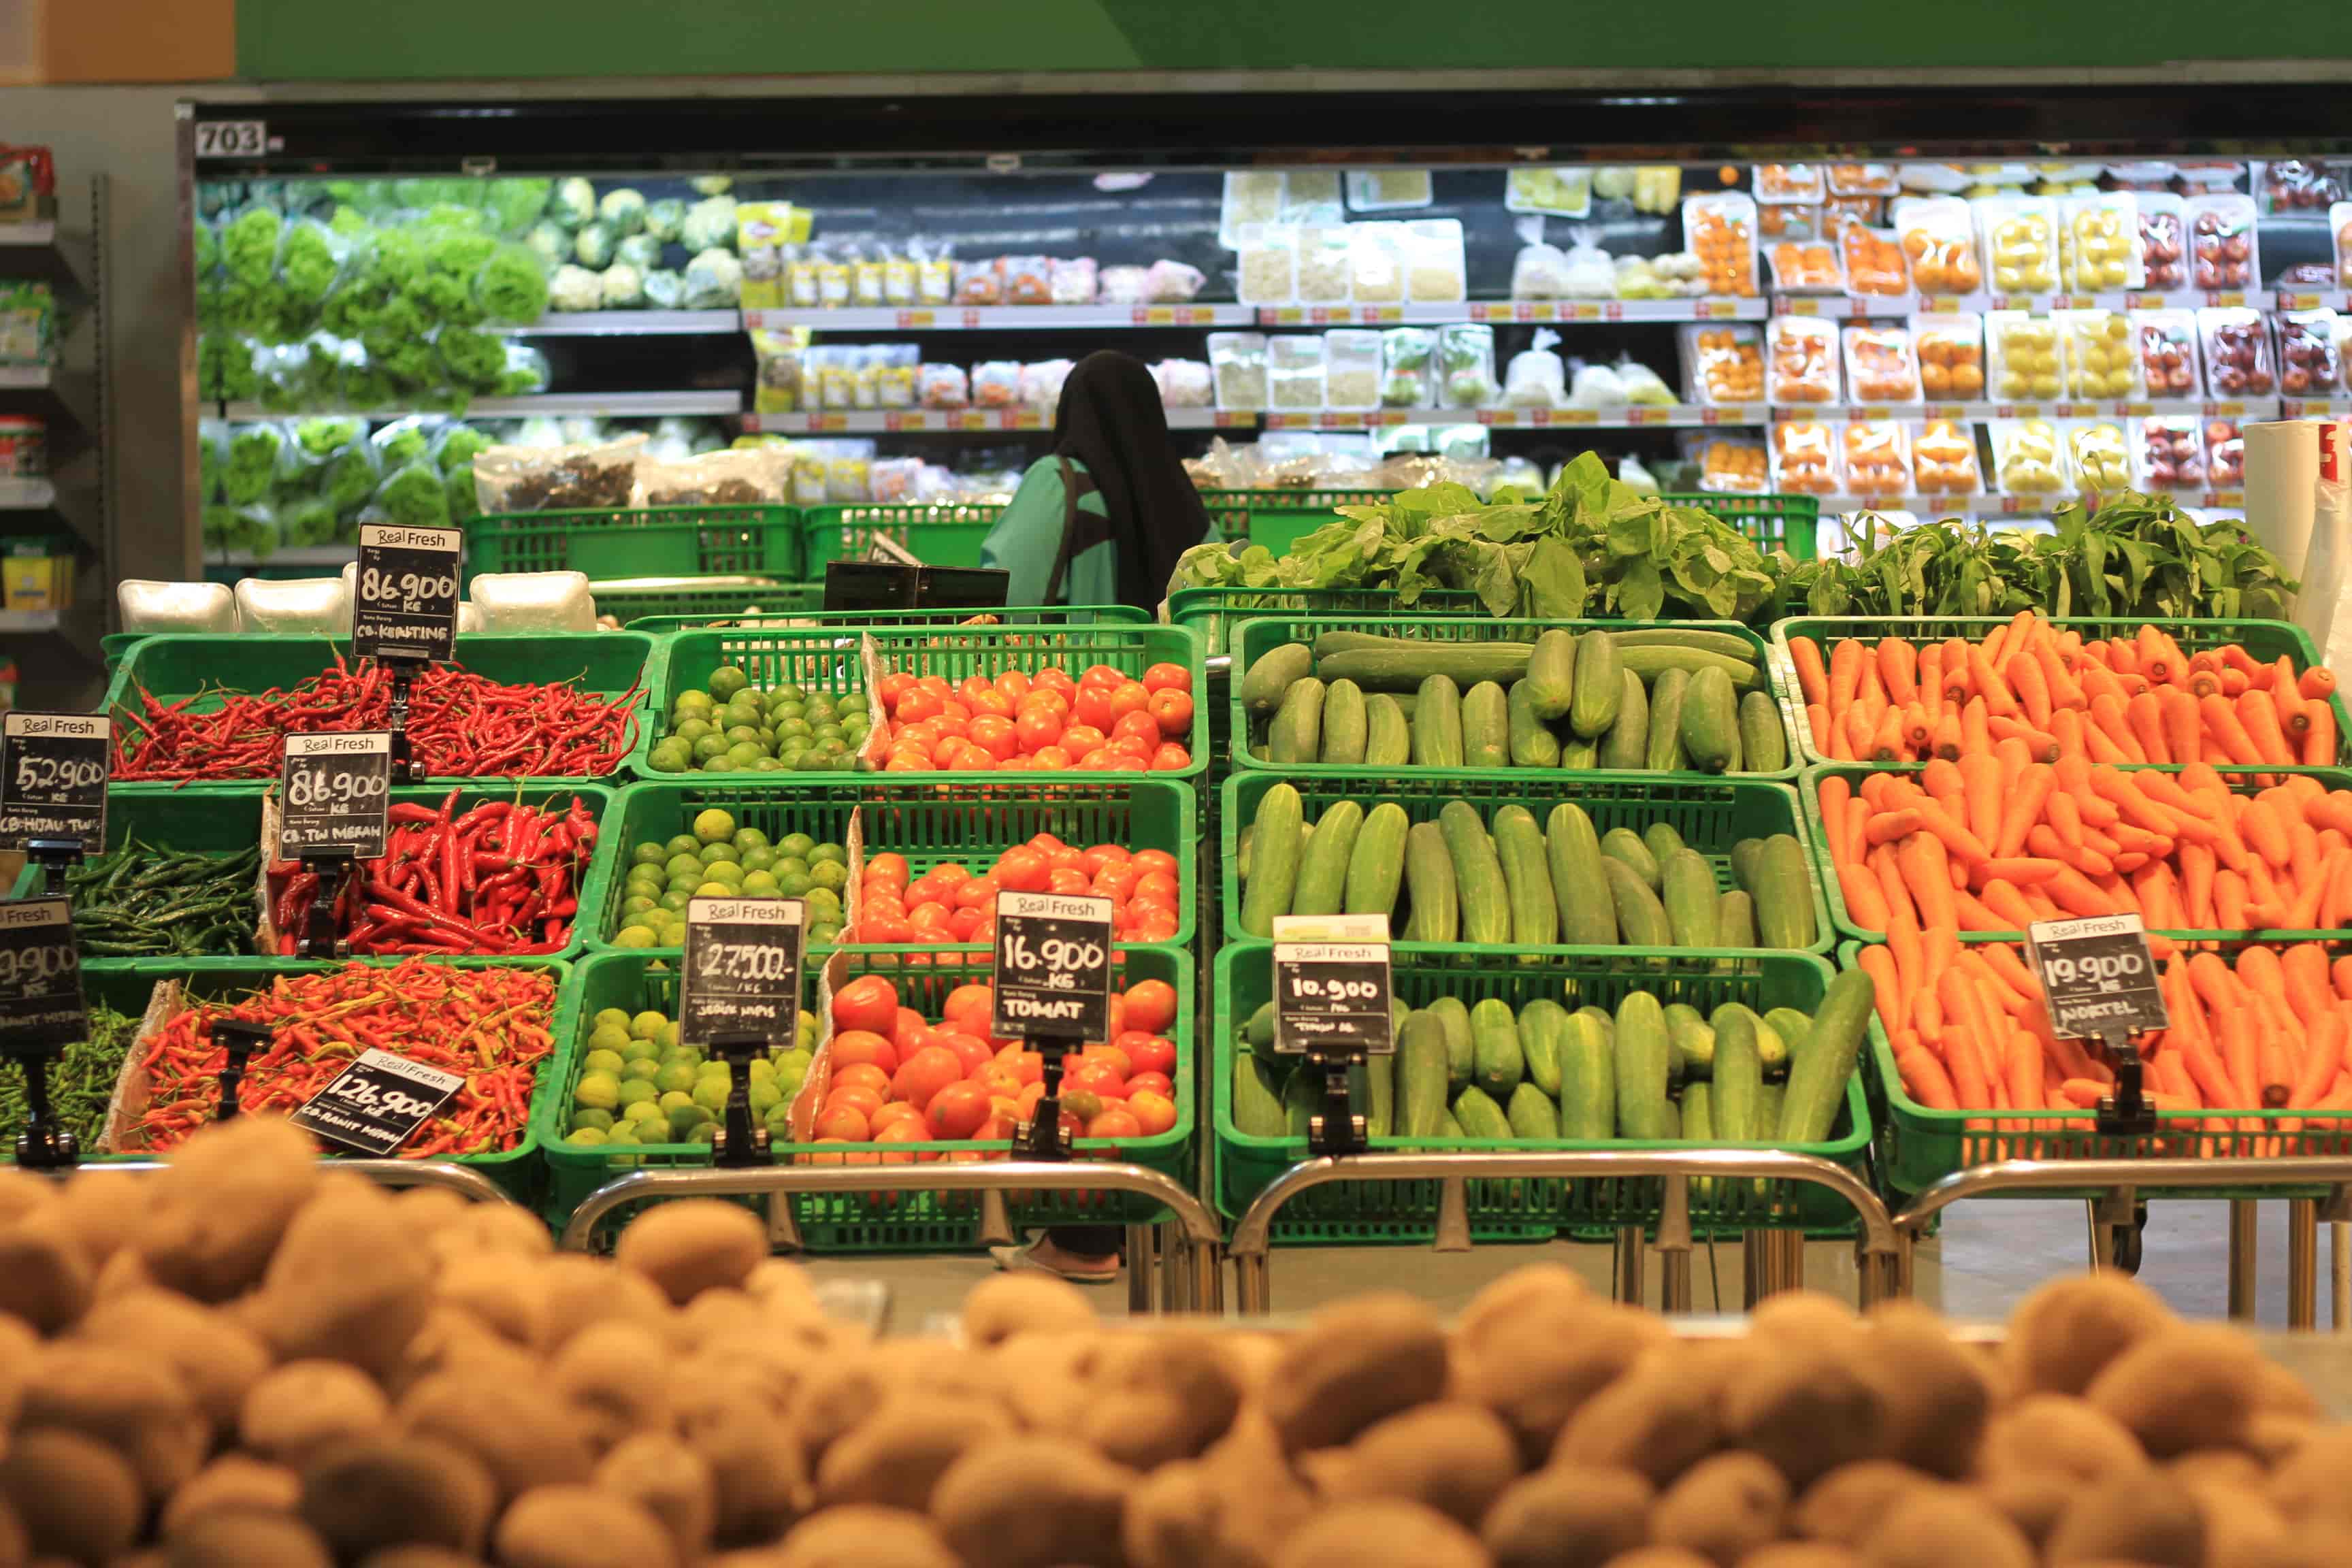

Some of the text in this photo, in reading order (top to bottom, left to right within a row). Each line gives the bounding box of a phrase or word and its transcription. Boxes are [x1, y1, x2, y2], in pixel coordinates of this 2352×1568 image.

[202, 127, 258, 152] 703
[376, 528, 446, 547] Real Fresh
[361, 568, 455, 601] 86.900
[22, 718, 95, 734] Real Fresh
[304, 737, 374, 753] Real Fresh
[16, 755, 105, 791] 52.900
[289, 770, 386, 806] 86.900
[6, 907, 52, 924] Fresh
[708, 903, 785, 920] Real Fresh
[1017, 898, 1095, 916] Real Fresh
[2050, 919, 2126, 939] Real Fresh
[1004, 934, 1105, 971] 16.900
[1295, 947, 1372, 960] Real Fresh
[2044, 953, 2143, 987] 19.900
[1292, 978, 1378, 1001] 10.900
[1002, 998, 1085, 1019] TOMAT
[375, 1056, 407, 1074] Real
[408, 1066, 447, 1085] Fresh
[327, 1073, 434, 1118] 126.900
